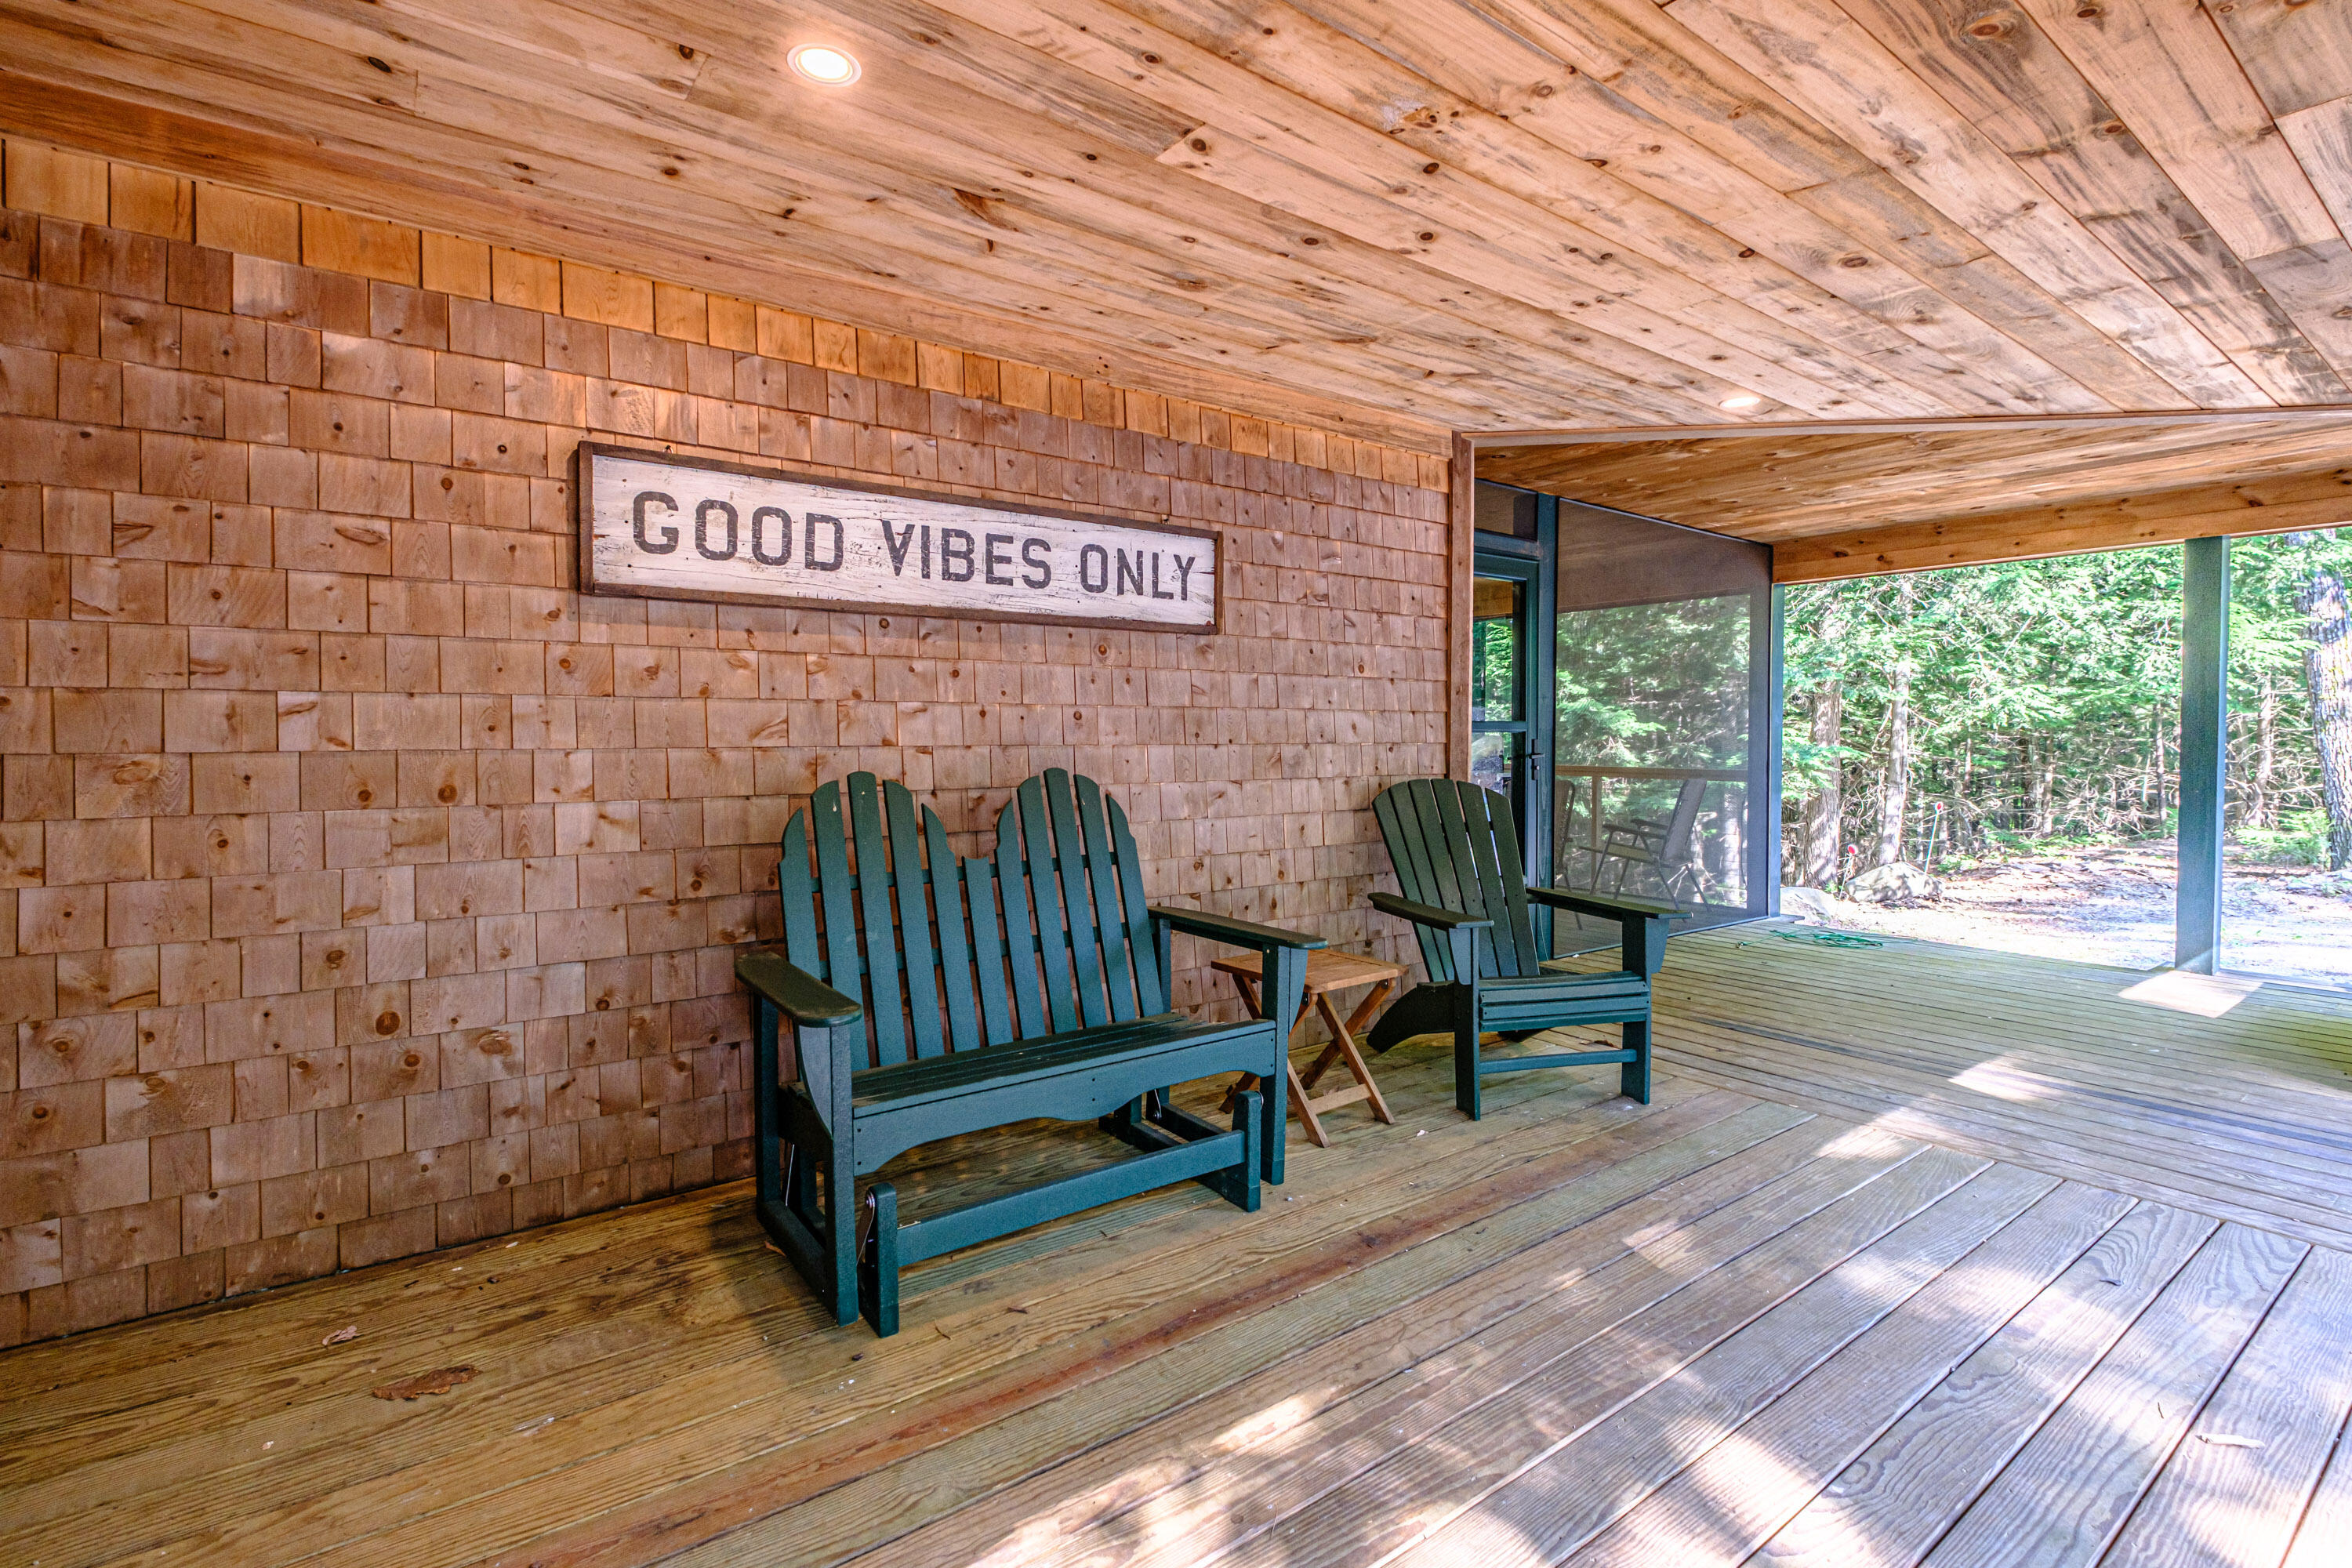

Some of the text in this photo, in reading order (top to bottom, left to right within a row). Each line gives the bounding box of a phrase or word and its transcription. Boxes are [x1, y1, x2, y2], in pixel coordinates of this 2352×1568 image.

[633, 490, 1196, 602] GOOD VIBES ONLY
